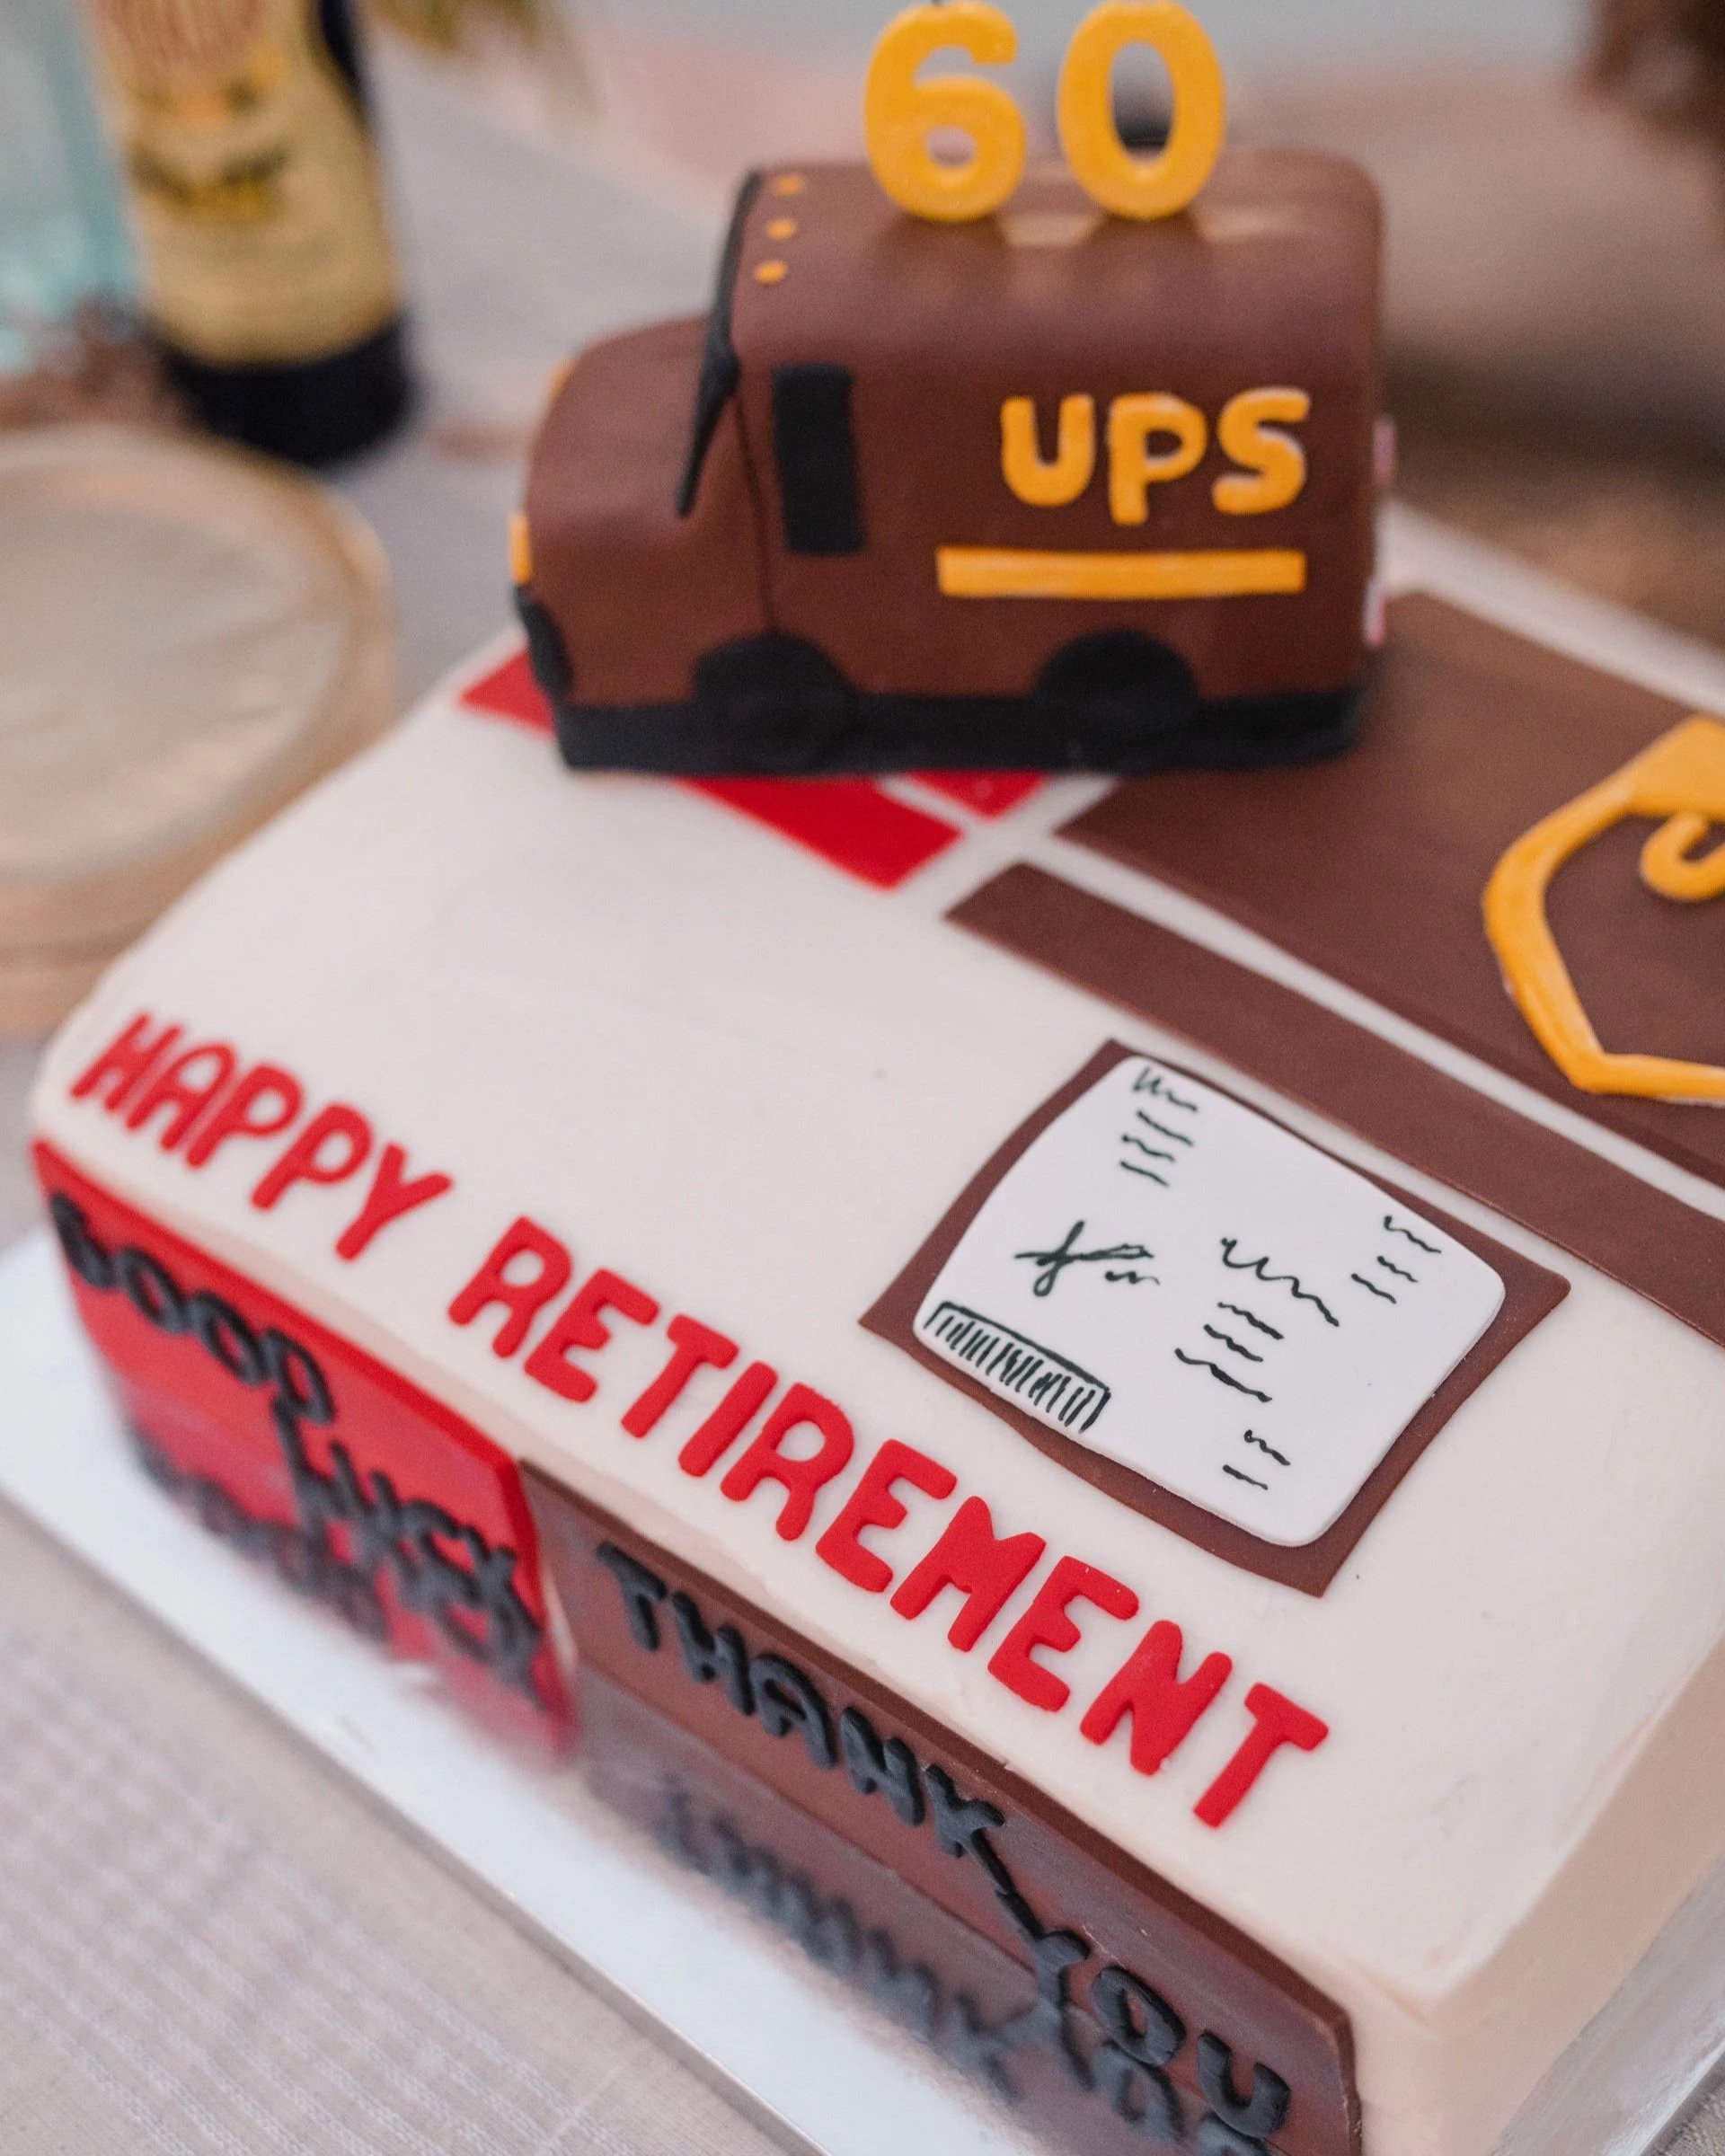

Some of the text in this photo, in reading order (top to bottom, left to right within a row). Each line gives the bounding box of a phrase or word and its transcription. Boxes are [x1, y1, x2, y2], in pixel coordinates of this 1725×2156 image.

[862, 0, 1225, 220] 60
[1002, 389, 1309, 524] UPS
[70, 1013, 452, 1262] HAPPY
[447, 1215, 1330, 1830] RETIREMENT
[595, 1542, 1016, 1895] THANK
[995, 1888, 1291, 2139] YOU
